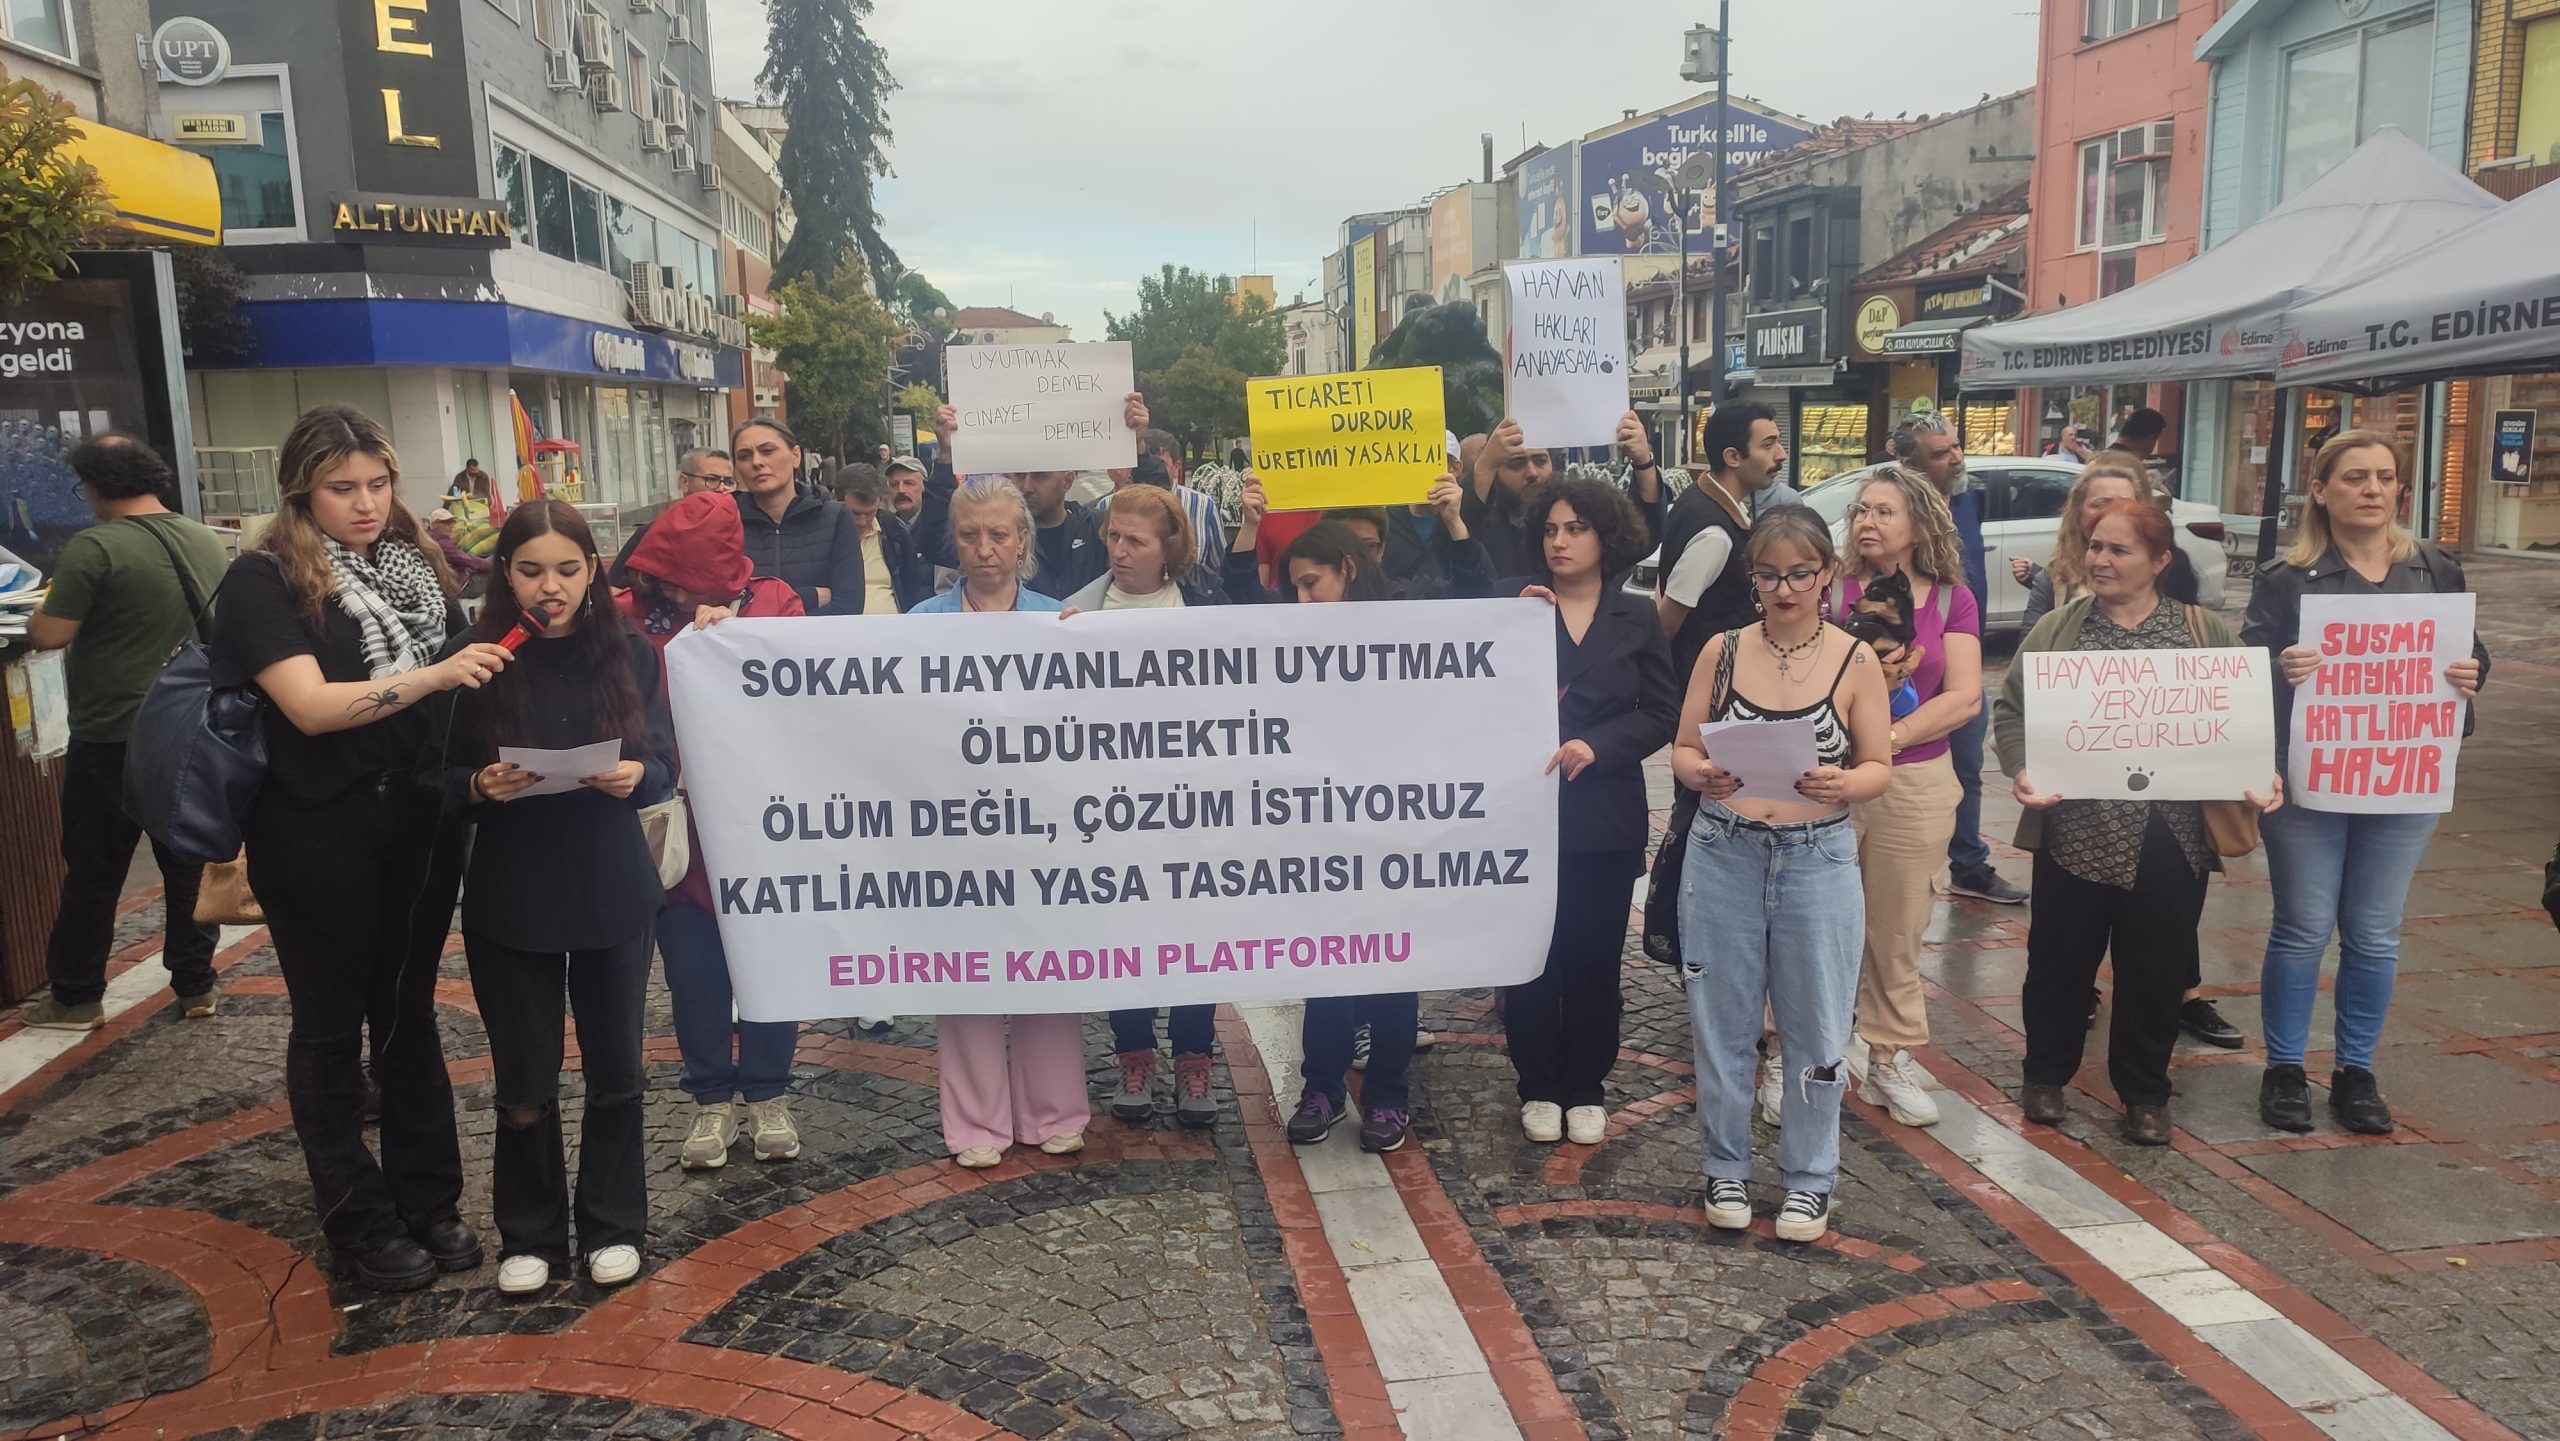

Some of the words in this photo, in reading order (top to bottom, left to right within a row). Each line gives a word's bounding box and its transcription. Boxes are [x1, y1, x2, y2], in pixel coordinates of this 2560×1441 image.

[163, 40, 215, 58] UPT
[333, 203, 512, 237] ALTUNHAN
[1521, 268, 1605, 300] HAYVAN
[1534, 312, 1597, 346] HAKLARI
[1756, 320, 1804, 360] PADİŞAH
[2240, 330, 2273, 346] Edirne
[2365, 319, 2419, 351] T.C.
[2431, 296, 2560, 343] EDİRNE
[970, 348, 1070, 370] UYUTMAK
[1894, 339, 1905, 350] ATA
[2002, 350, 2028, 371] T.C.
[2033, 343, 2094, 369] EDİRNE
[2098, 323, 2213, 364] BELEDİYESİ
[2306, 338, 2348, 356] Edirne
[0, 347, 73, 378] geldi
[1513, 348, 1599, 379] ANAYASAYA
[1037, 373, 1104, 394] DEMEK
[1264, 377, 1374, 410] TİCARETİ
[1044, 416, 1112, 441] DEMEK!
[1331, 407, 1418, 435] DURDUR,
[1257, 445, 1339, 471] ÜRETİMİ
[1344, 441, 1442, 467] YASAKLA!
[2320, 619, 2436, 657] SUSMA
[741, 656, 905, 698] SOKAK
[920, 647, 1258, 694] HAYVANLARINI
[1274, 640, 1497, 685] UYUTMAK
[2036, 655, 2159, 690] HAYVANA
[2175, 652, 2253, 681] İNSANA
[2315, 656, 2434, 696] HAYKIR
[2089, 684, 2230, 720] YERYÜZÜNE
[960, 708, 1292, 765] ÖLDÜRMEKTİR
[2066, 718, 2231, 752] ÖZGÜRLÜK
[2305, 700, 2457, 743] KATLİAMA
[2307, 744, 2443, 797] HAYIR
[762, 793, 895, 842] ÖLÜM
[910, 788, 1057, 844] DEĞİL,
[1073, 783, 1235, 843] ÇÖZÜM
[1250, 776, 1487, 826] İSTİYORUZ
[719, 863, 1016, 915] KATLİAMDAN
[1030, 864, 1150, 906] YASA
[1162, 855, 1364, 900] TASARISI
[1379, 848, 1530, 890] OLMAZ
[829, 945, 991, 987] EDİRNE
[1005, 946, 1142, 983] KADIN
[1157, 932, 1412, 976] PLATFORMU
